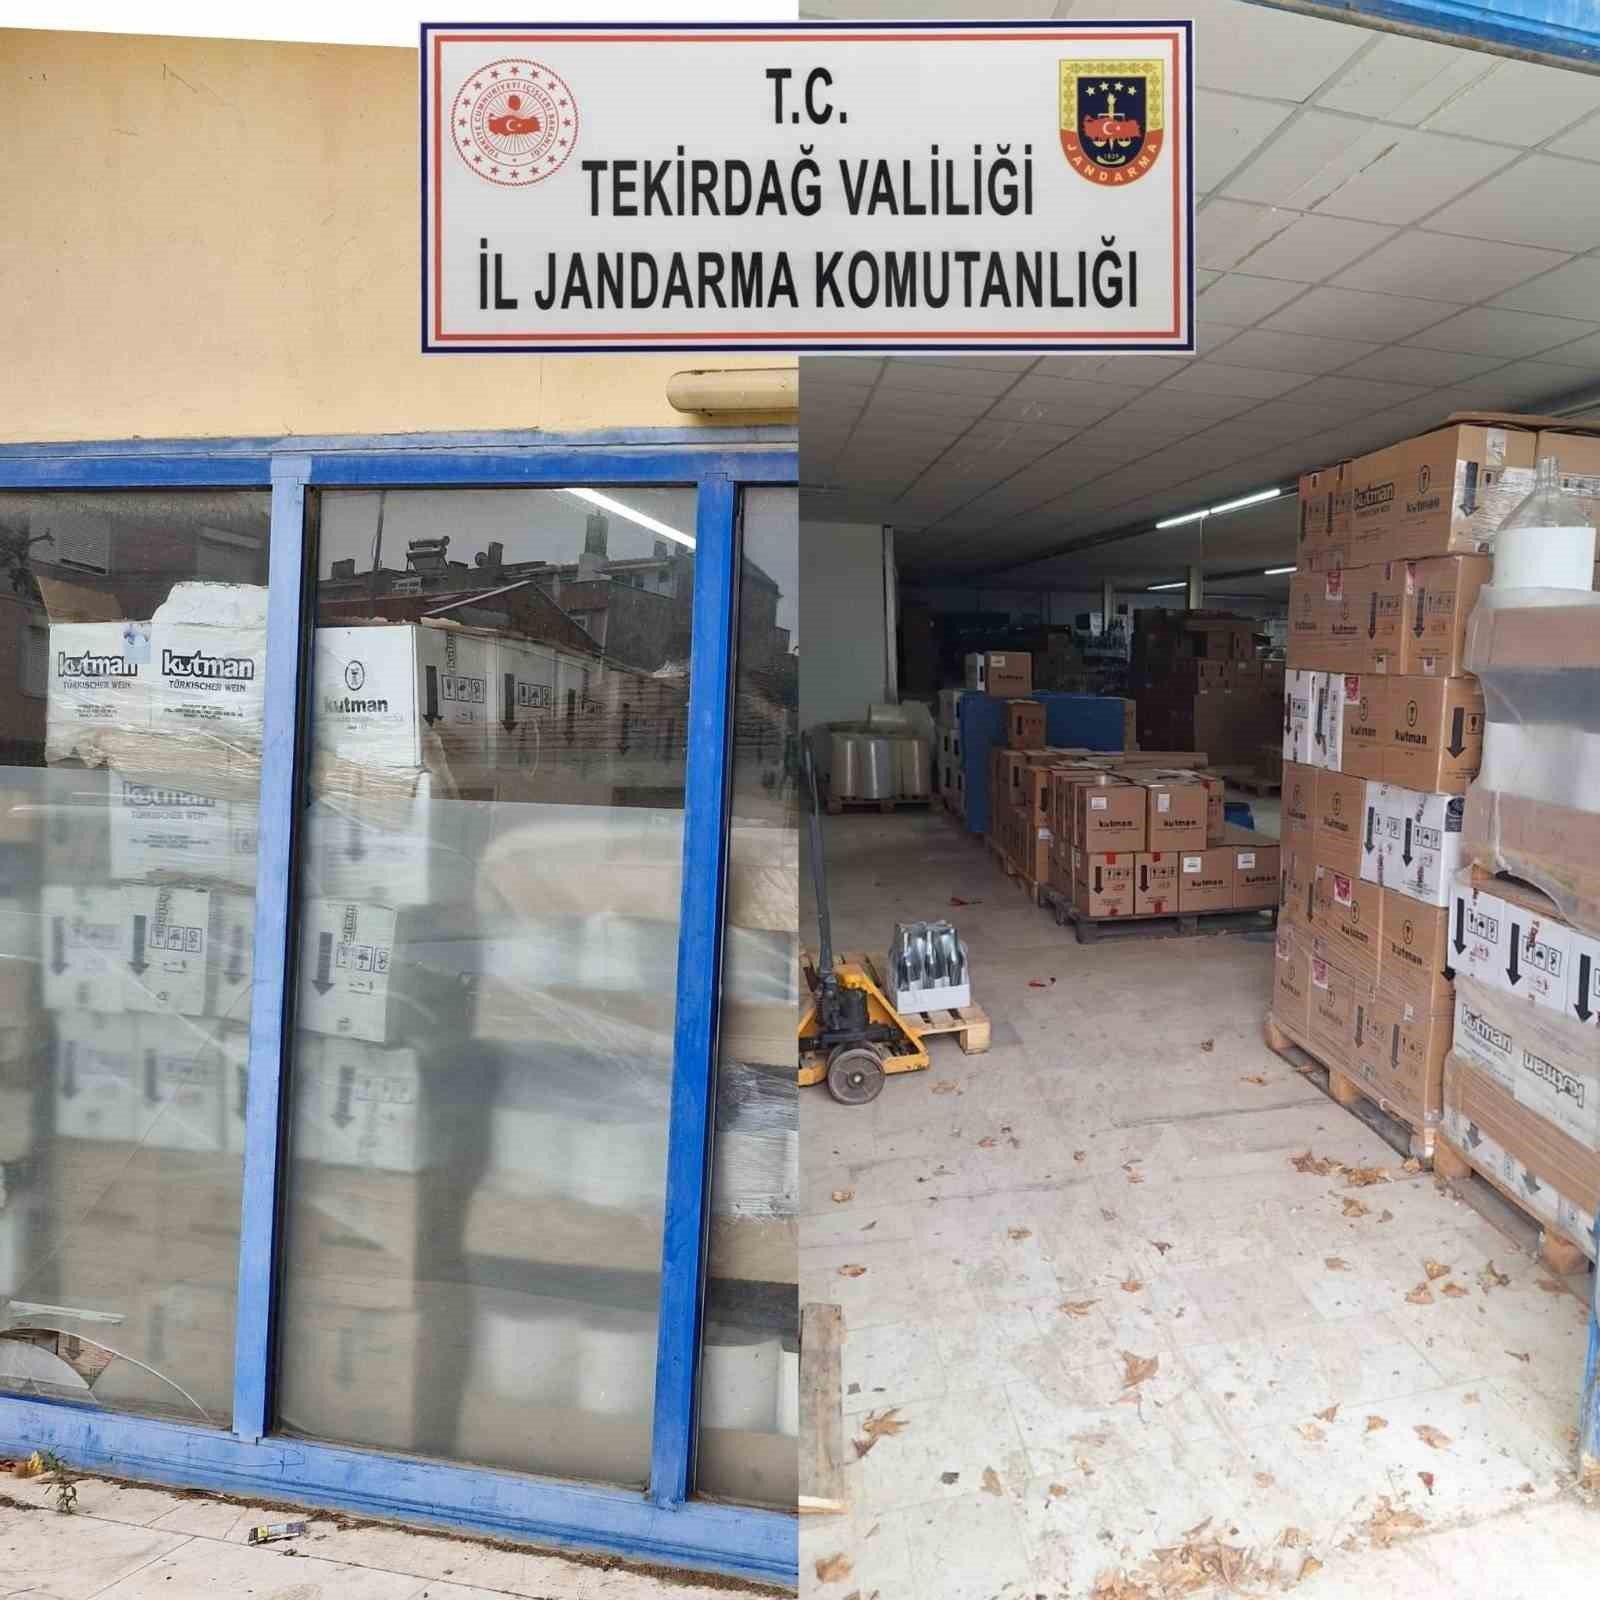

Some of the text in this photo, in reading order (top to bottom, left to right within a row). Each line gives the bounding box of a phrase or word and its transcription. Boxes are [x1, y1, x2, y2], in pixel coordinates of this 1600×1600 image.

[162, 649, 254, 680] kutman
[224, 682, 247, 693] WEIN
[323, 696, 389, 714] kutman
[1394, 728, 1427, 746] kutman
